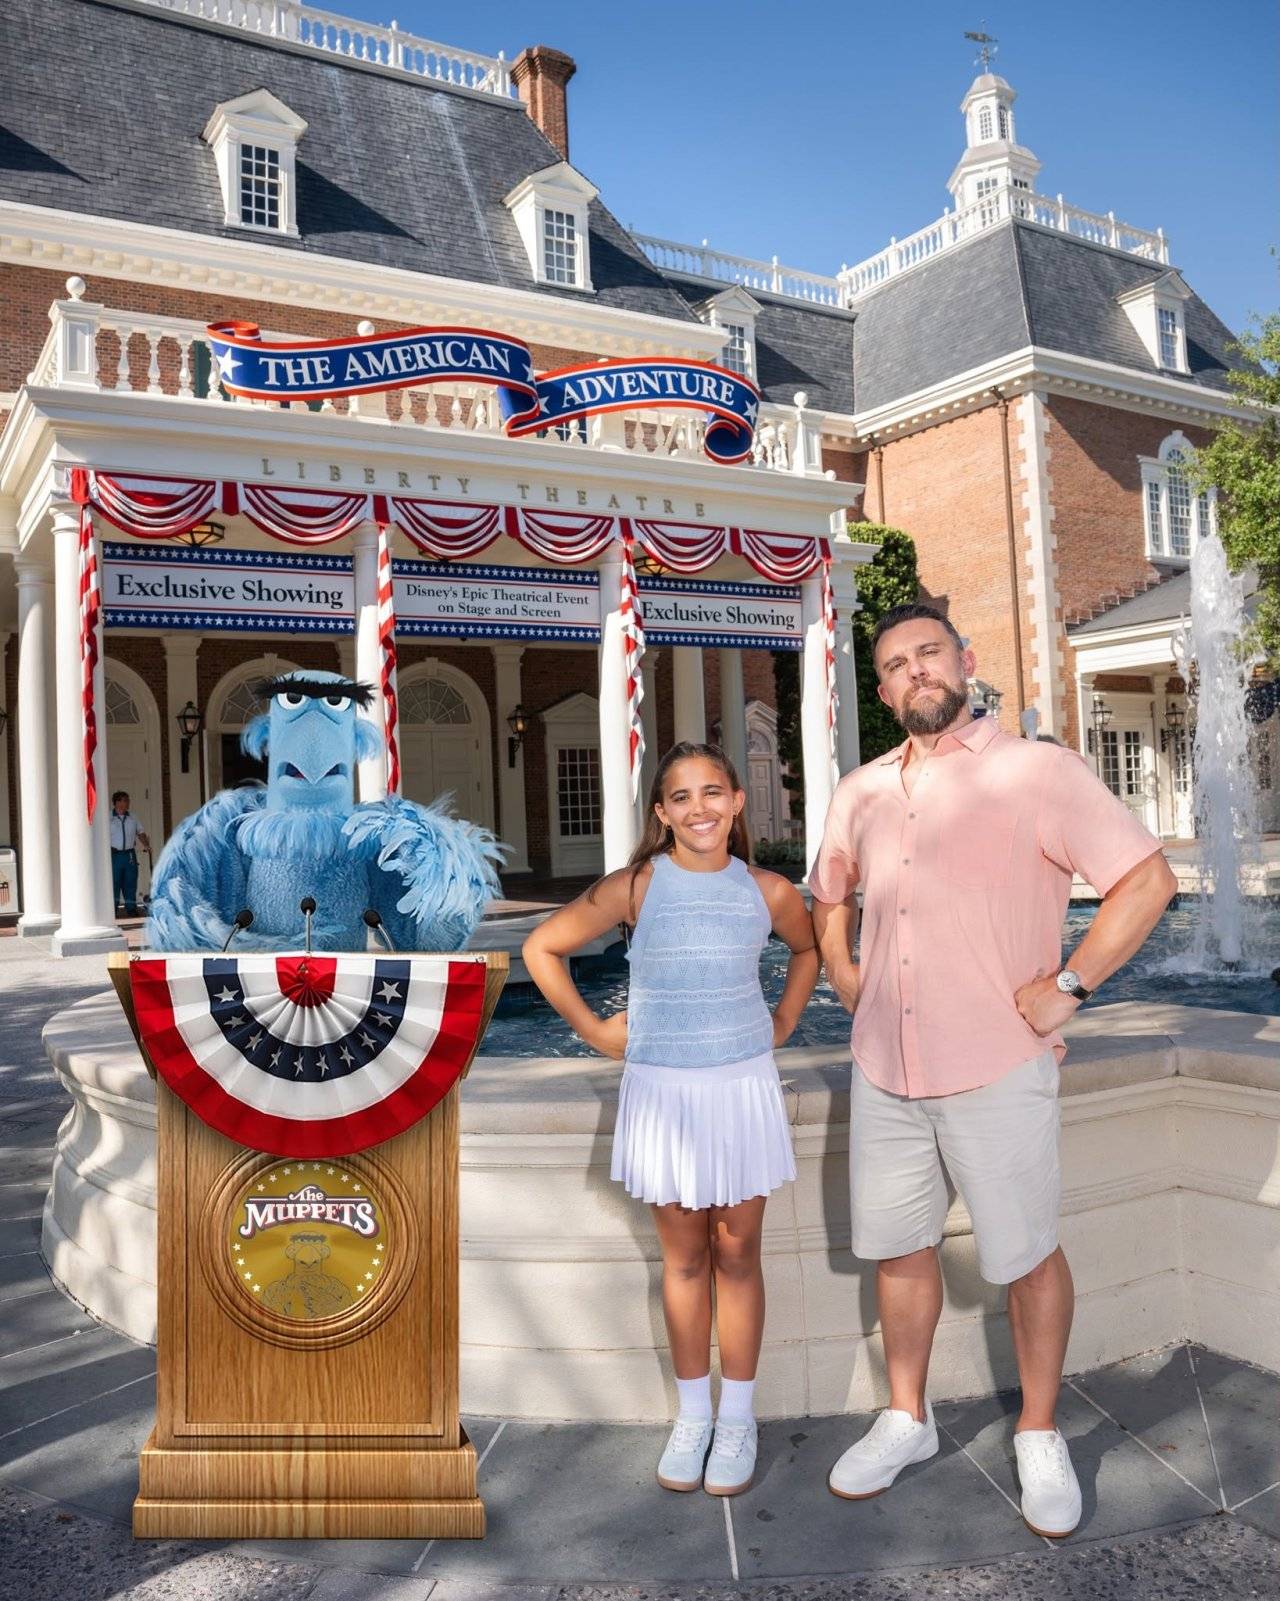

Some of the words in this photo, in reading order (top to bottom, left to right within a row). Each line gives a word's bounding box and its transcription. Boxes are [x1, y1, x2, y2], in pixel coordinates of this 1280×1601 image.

[259, 356, 335, 386] THE
[343, 340, 510, 380] AMERICAN
[561, 370, 735, 408] ADVENTURE
[262, 458, 472, 494] LIBERTY
[517, 484, 705, 517] THEATRE
[116, 574, 235, 600] Exclusive
[242, 579, 344, 609] Showing
[406, 584, 458, 599] Disney's
[462, 588, 489, 602] Epic
[491, 588, 552, 603] Theatrical
[556, 592, 589, 605] Event
[438, 603, 454, 613] on
[458, 602, 491, 617] Stage
[495, 603, 517, 616] and
[521, 605, 561, 618] Screen
[642, 601, 722, 623] Exclusive
[726, 606, 795, 630] Showing
[288, 1185, 324, 1201] The
[239, 1202, 376, 1236] MUPPETS
